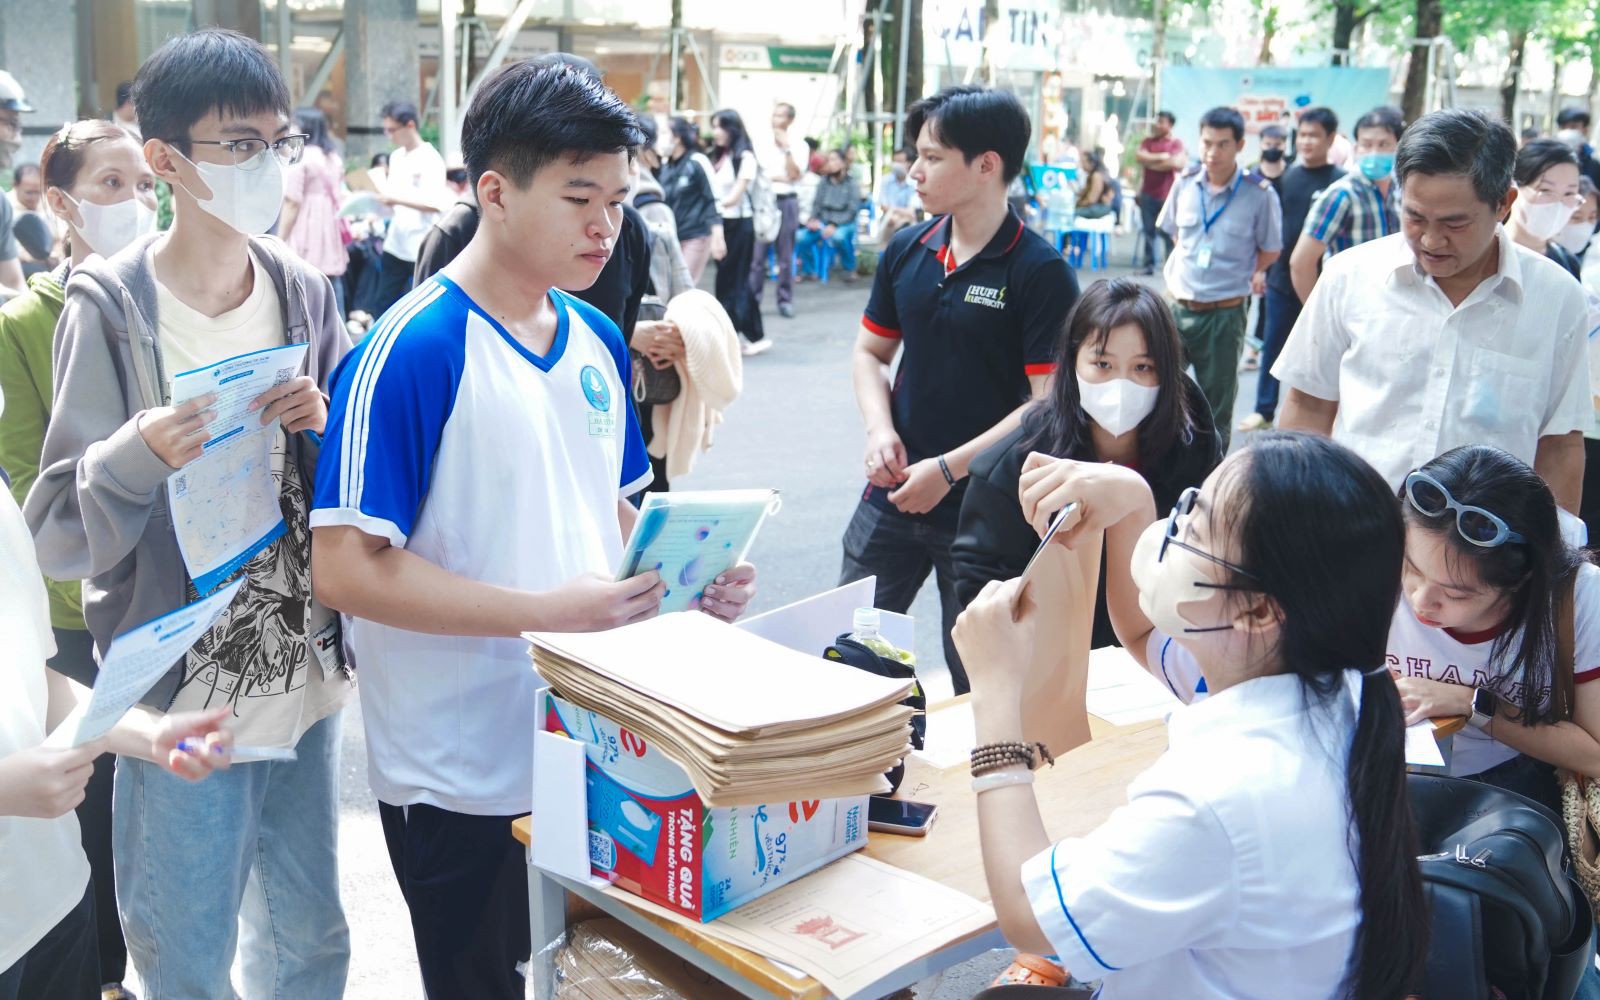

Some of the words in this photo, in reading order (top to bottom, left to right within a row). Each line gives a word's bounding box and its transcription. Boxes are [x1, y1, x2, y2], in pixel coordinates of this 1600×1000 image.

[964, 294, 1006, 309] ELECTRICITY
[970, 284, 998, 299] HUFI
[677, 808, 697, 863] TẶNG
[680, 866, 696, 910] QUÀ
